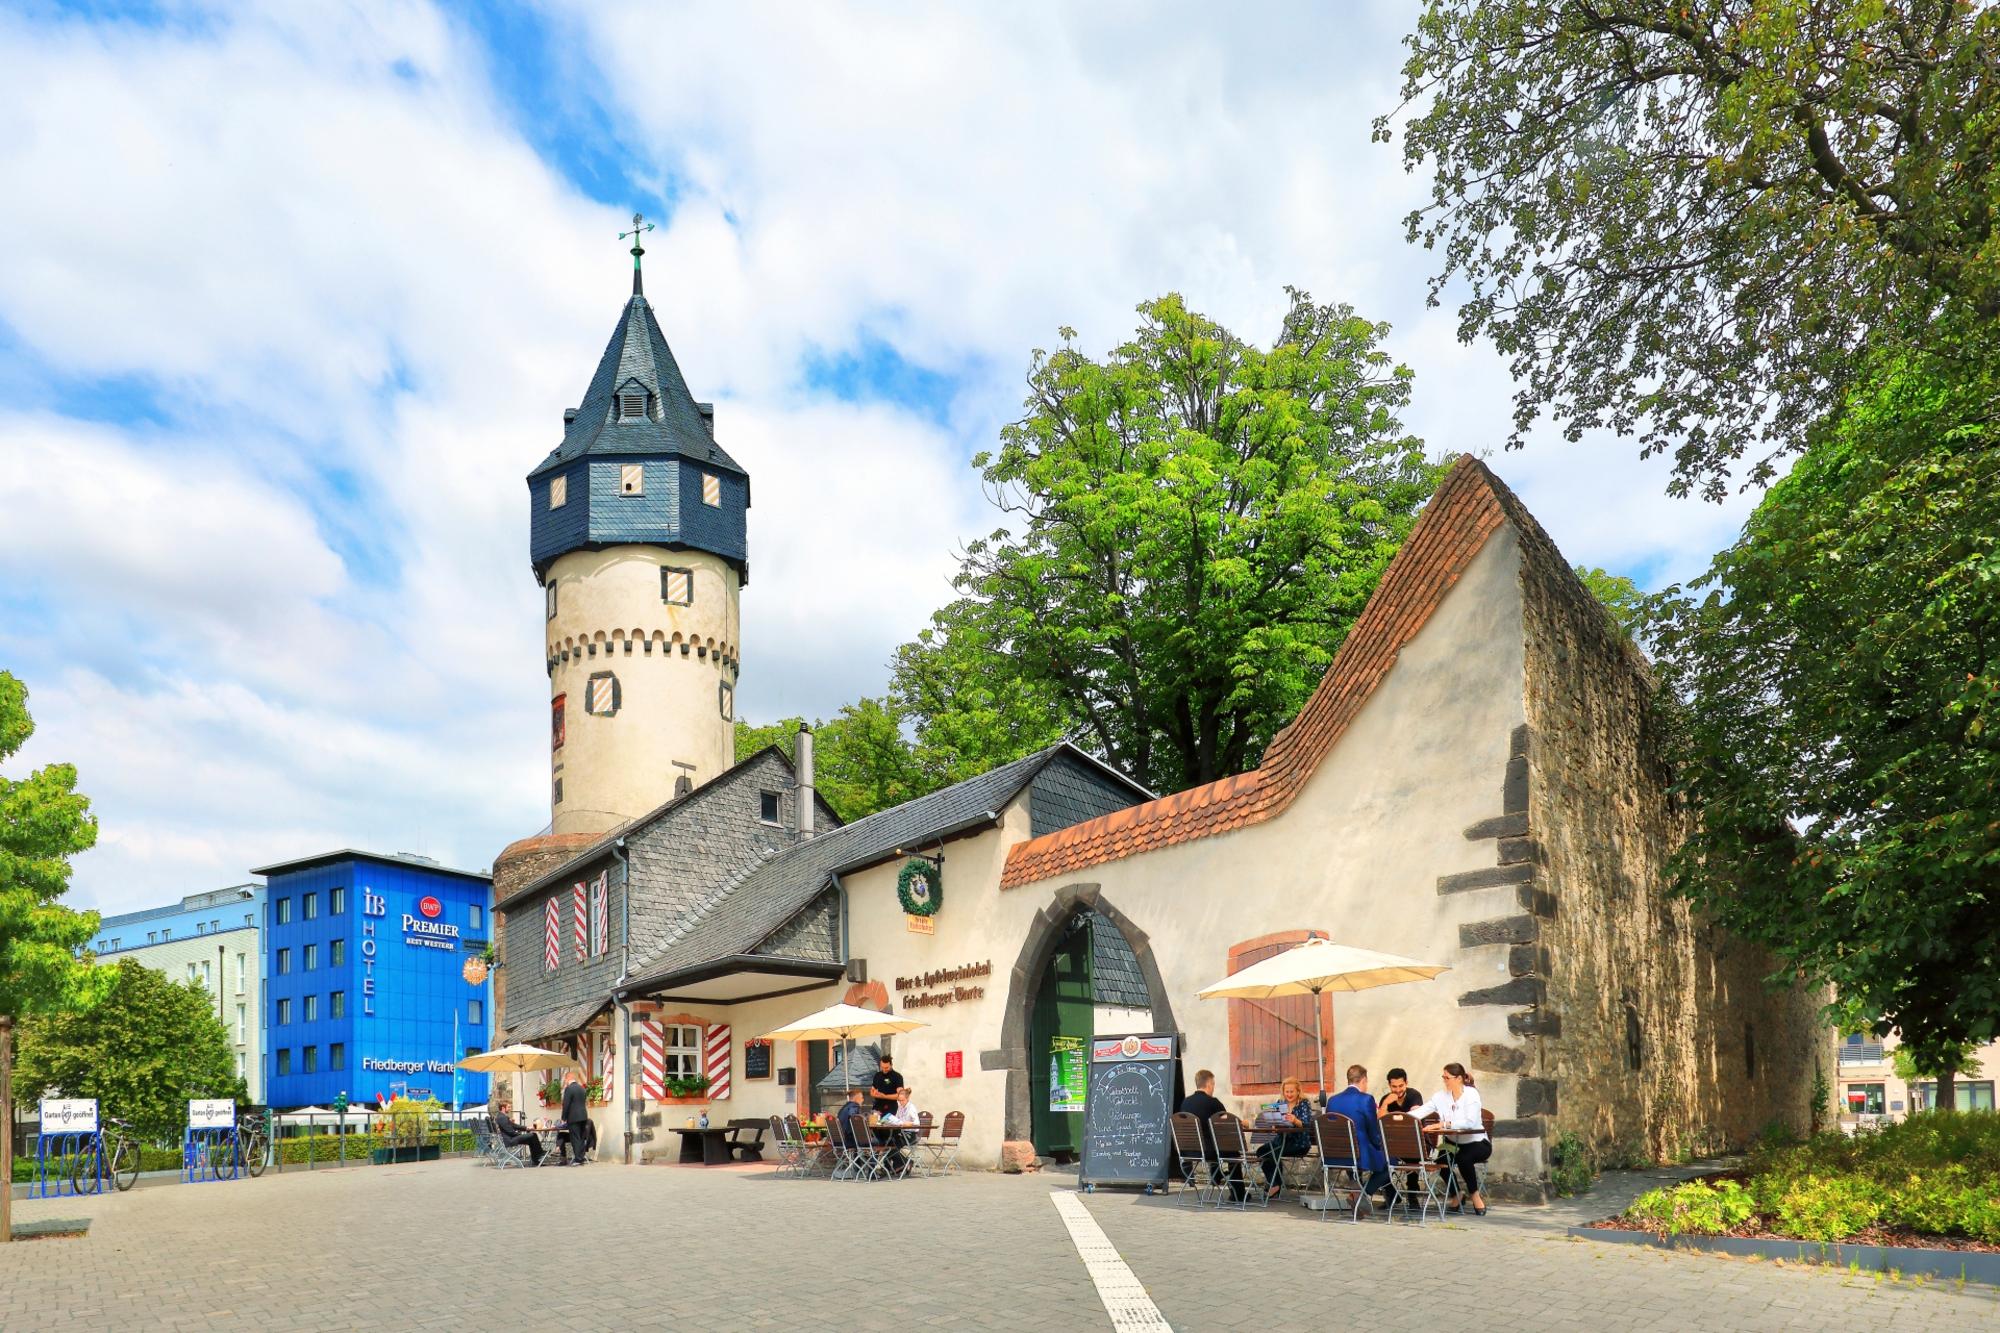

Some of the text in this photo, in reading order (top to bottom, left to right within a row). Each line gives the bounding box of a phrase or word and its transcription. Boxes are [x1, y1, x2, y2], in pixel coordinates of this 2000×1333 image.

[406, 937, 422, 946] BEST
[424, 939, 454, 950] WESTERN
[362, 920, 376, 1014] HOTEL
[896, 976, 913, 990] Bier
[903, 986, 984, 1009] Friedberger Warte
[362, 1057, 454, 1074] Friedberger Warte
